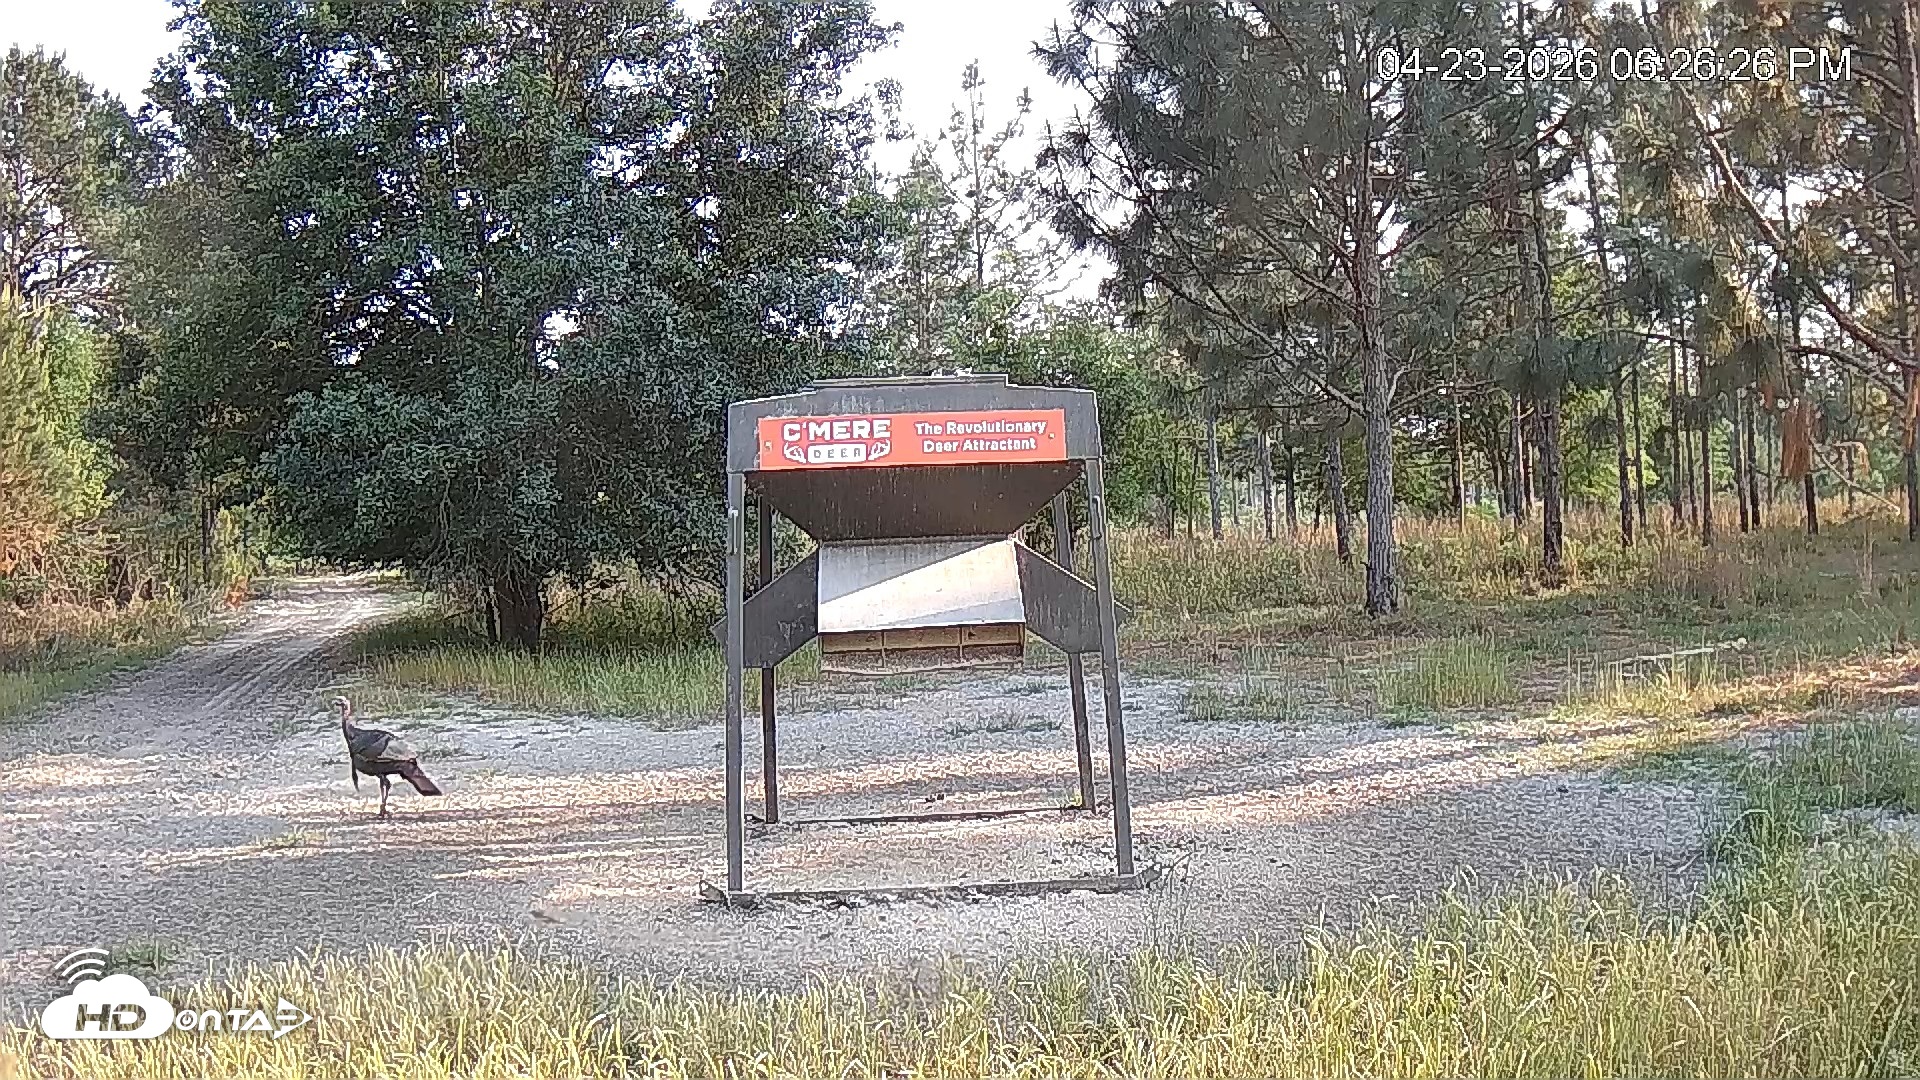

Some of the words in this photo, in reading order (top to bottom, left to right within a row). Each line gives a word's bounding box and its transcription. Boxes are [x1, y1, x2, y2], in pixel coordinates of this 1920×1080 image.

[783, 419, 892, 442] C'MERE
[914, 420, 943, 435] The
[946, 419, 1048, 435] Revolutionary
[812, 446, 863, 460] DEER
[922, 439, 959, 453] Deer
[962, 437, 1037, 452] Attractant
